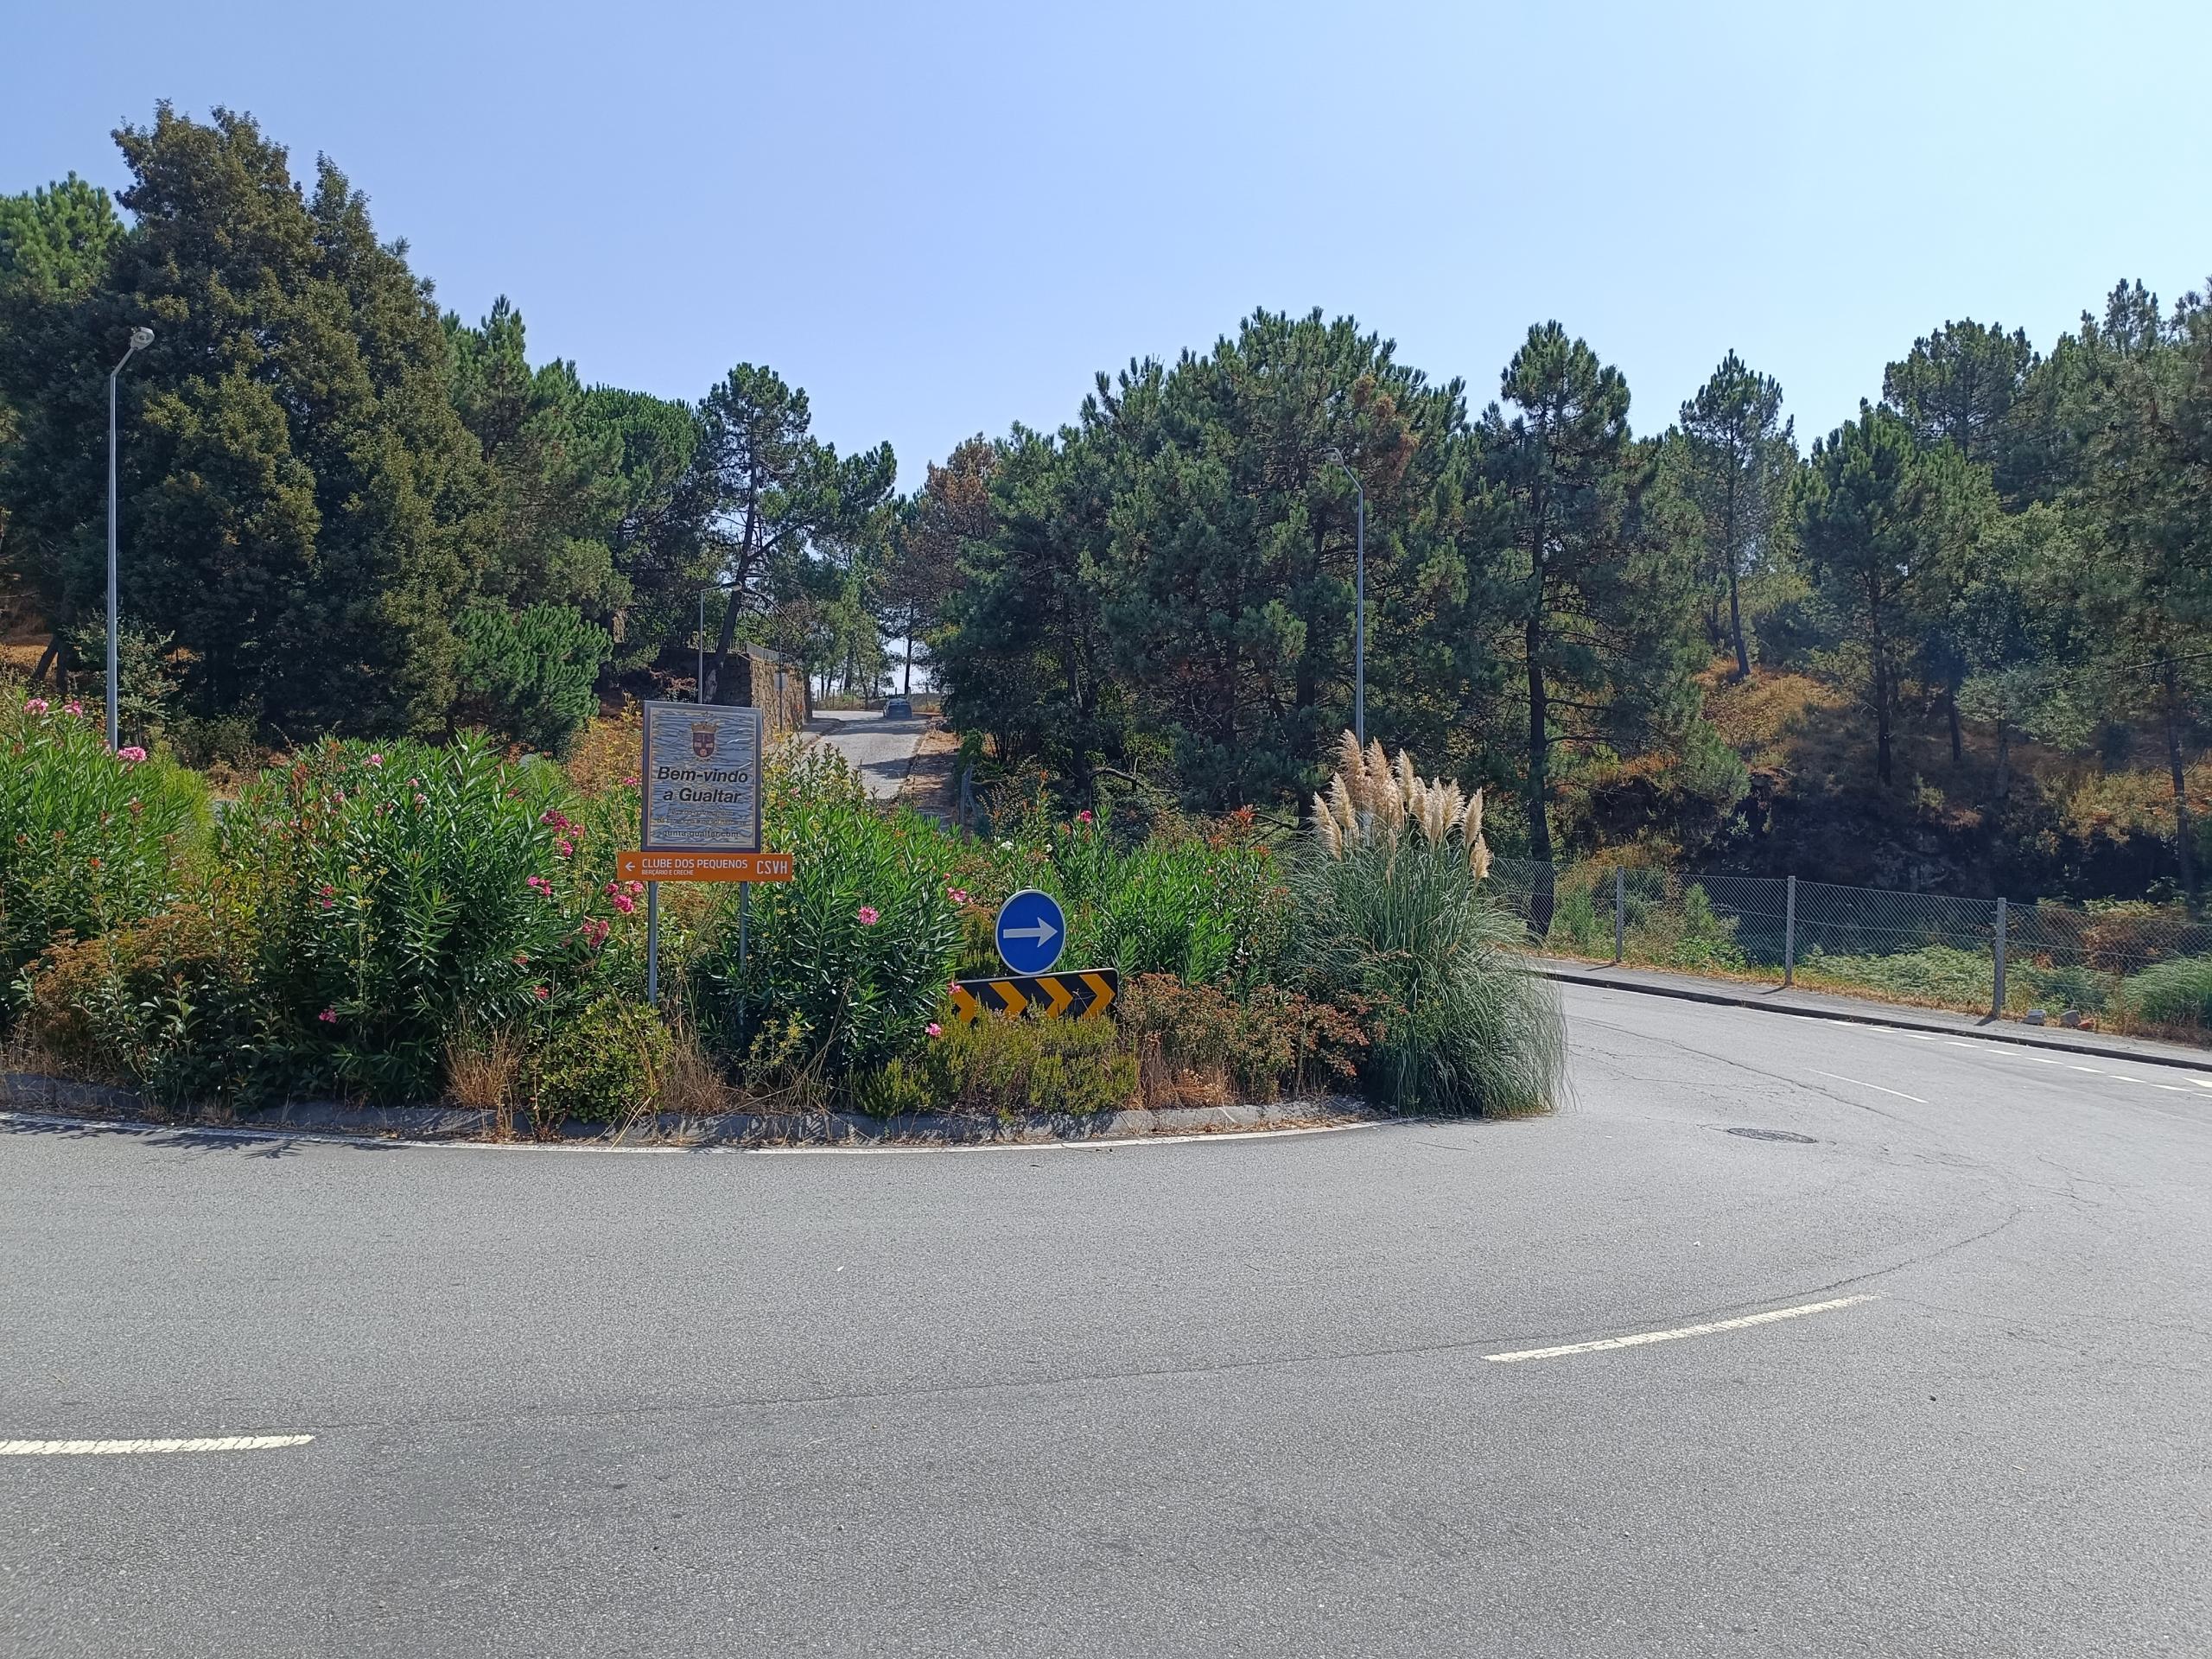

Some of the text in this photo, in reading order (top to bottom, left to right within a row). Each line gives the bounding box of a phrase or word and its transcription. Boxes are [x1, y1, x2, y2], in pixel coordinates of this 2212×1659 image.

[657, 766, 748, 783] Bem-vindo
[663, 788, 741, 803] a Gualtar
[642, 858, 748, 870] CLUBE DOS PEQUENOS
[756, 860, 788, 875] CSVH
